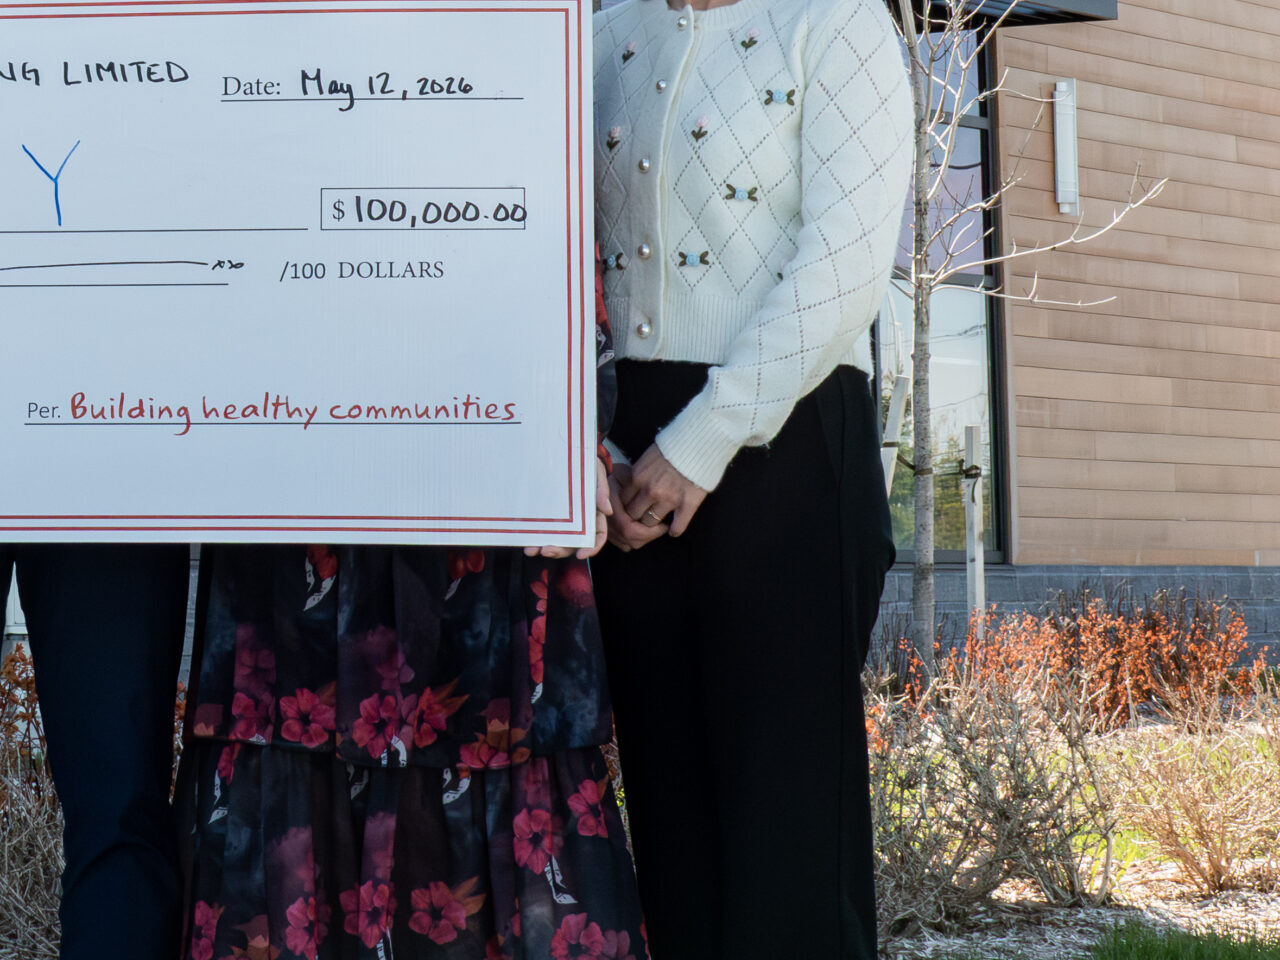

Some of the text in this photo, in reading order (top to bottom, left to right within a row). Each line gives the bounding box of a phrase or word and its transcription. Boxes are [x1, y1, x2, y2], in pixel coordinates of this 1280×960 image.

[63, 60, 190, 87] LIMITED
[221, 76, 281, 96] Date:
[300, 68, 355, 112] May
[416, 76, 474, 96] 2026
[21, 139, 81, 227] Y
[279, 260, 445, 283] /100 DOLLARS
[27, 402, 62, 420] Per.
[70, 391, 517, 436] Building healthy communities
